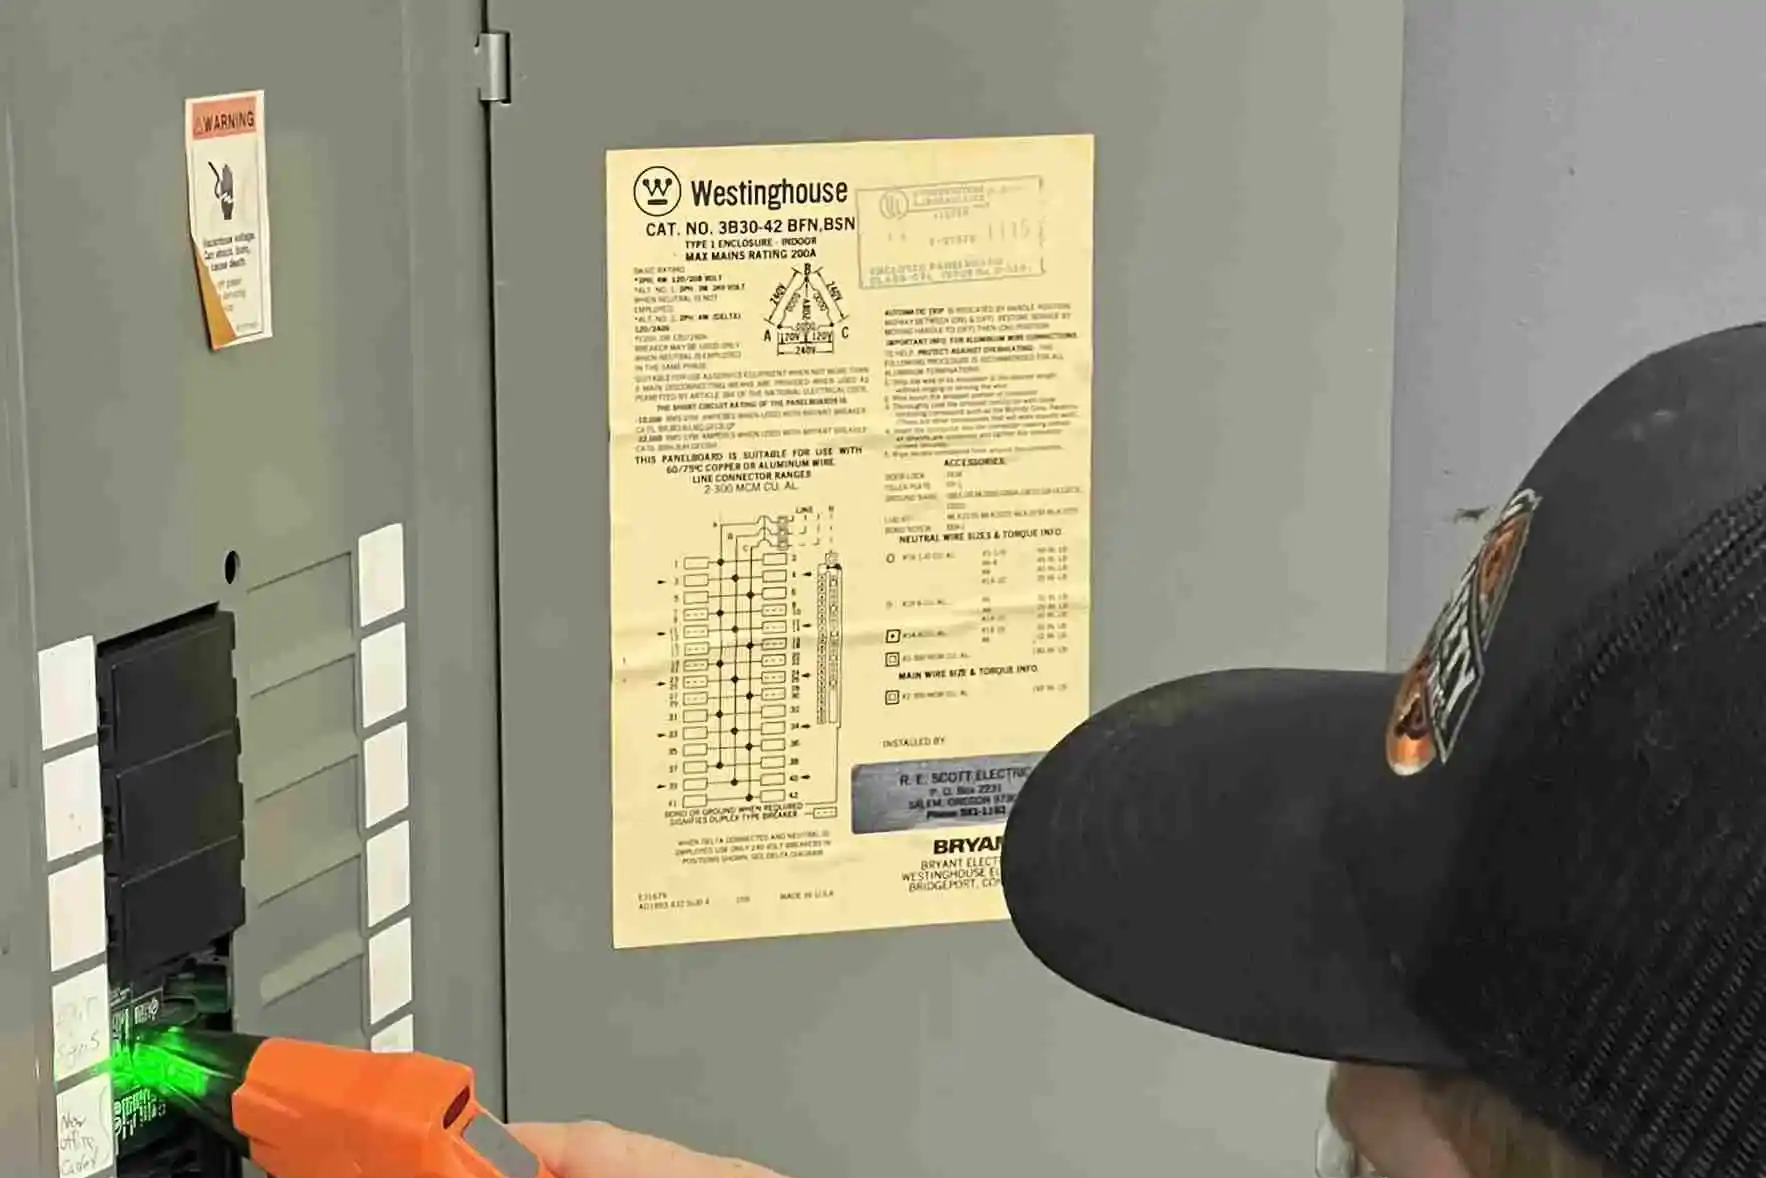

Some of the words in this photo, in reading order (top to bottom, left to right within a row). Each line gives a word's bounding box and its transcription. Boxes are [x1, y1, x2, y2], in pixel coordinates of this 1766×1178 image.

[203, 111, 255, 133] WARNING
[691, 178, 848, 211] Westinghouse
[646, 222, 681, 236] CAT.
[686, 221, 713, 235] NO.
[719, 219, 783, 235] 3B30-42
[788, 217, 856, 233] BFN,BSN
[685, 240, 707, 249] TYPE
[718, 238, 773, 248] ENCLOSURE
[782, 237, 817, 247] INDOOR
[685, 252, 708, 261] MAX
[712, 251, 745, 261] MAINS
[749, 249, 788, 260] RATING
[791, 248, 816, 258] 200A
[764, 330, 771, 341] A
[842, 326, 849, 339] C
[635, 456, 656, 464] THIS
[662, 453, 723, 463] PANELBOARD
[729, 452, 737, 460] IS
[743, 450, 787, 459] SUITABLE
[792, 449, 810, 457] FOR
[816, 448, 832, 456] USE
[839, 446, 863, 455] WITH
[705, 462, 742, 472] COPPER
[743, 462, 755, 470] OR
[758, 459, 809, 470] ALUMINUM
[693, 474, 713, 484] LINE
[715, 472, 772, 482] CONNECTOR
[775, 470, 812, 480] RANGES
[736, 482, 761, 492] MCM
[899, 534, 939, 544] NEUTRAL
[944, 533, 964, 541] WIRE
[968, 531, 991, 541] SIZES
[994, 531, 1000, 539] &
[1003, 529, 1037, 539] TORQUE
[899, 672, 922, 680] MAIN
[924, 670, 946, 679] WIRE
[950, 669, 965, 678] SIZE
[979, 666, 1013, 676] TORQUE
[883, 738, 931, 748] INSTALLED
[933, 737, 945, 745] BY
[931, 770, 972, 783] SCOTT
[702, 807, 736, 816] GROUND
[739, 806, 761, 814] WHEN
[920, 859, 963, 870] BRYANT
[902, 866, 985, 882] WESTINGHOUSE
